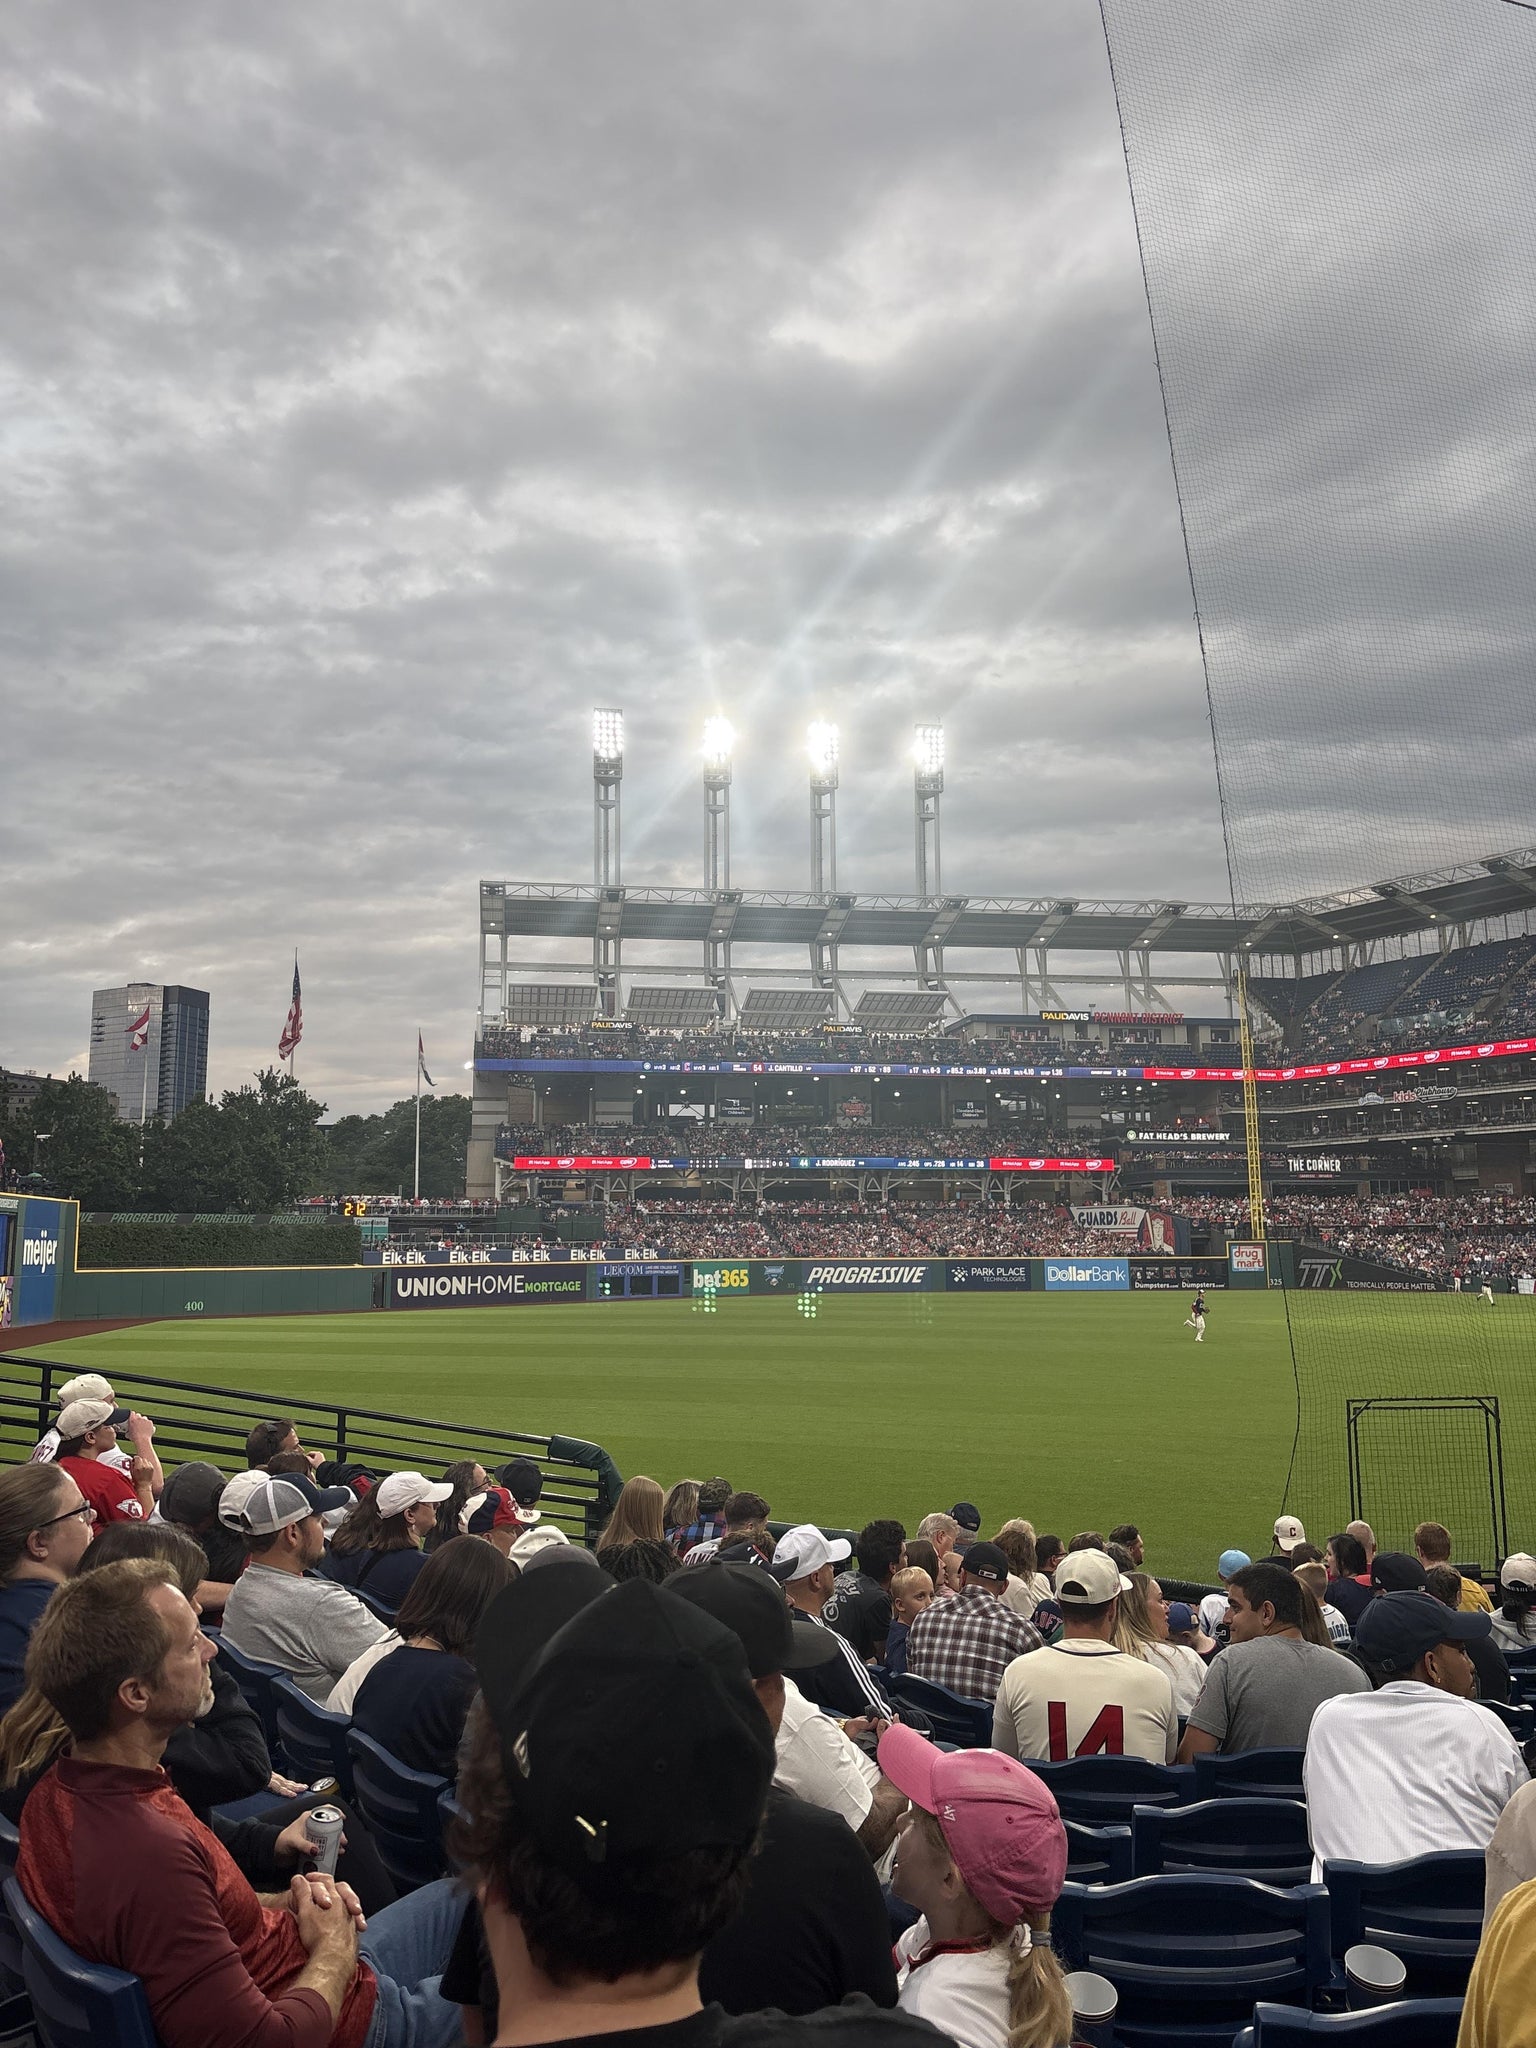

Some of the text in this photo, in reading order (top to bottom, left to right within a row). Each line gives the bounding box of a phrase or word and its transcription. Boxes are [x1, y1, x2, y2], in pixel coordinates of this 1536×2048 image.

[1142, 1012, 1184, 1024] DISTRICT
[1393, 1091, 1416, 1102] kids
[1416, 1086, 1455, 1096] Clubhouse
[822, 1158, 855, 1166] RODRÍGUEZ
[1289, 1159, 1341, 1172] THE CORNER
[344, 1202, 366, 1216] 2:12
[110, 1212, 179, 1224] PROGRESSIVE
[192, 1214, 256, 1224] PROGRESSIVE
[269, 1214, 328, 1225] PROGRESSIVE
[1078, 1211, 1118, 1226] GUARDS
[23, 1230, 58, 1274] meijer
[1234, 1246, 1258, 1260] drug
[1237, 1259, 1264, 1267] mart
[806, 1267, 926, 1284] PROGRESSIVE
[972, 1267, 1025, 1276] PARK PLACE
[694, 1269, 749, 1288] bet365
[525, 1281, 581, 1292] MORTGAGE
[1347, 1281, 1385, 1289] TECHNICALLY,
[184, 1302, 204, 1311] 400
[1289, 1527, 1296, 1537] C
[1048, 1701, 1123, 1762] 14
